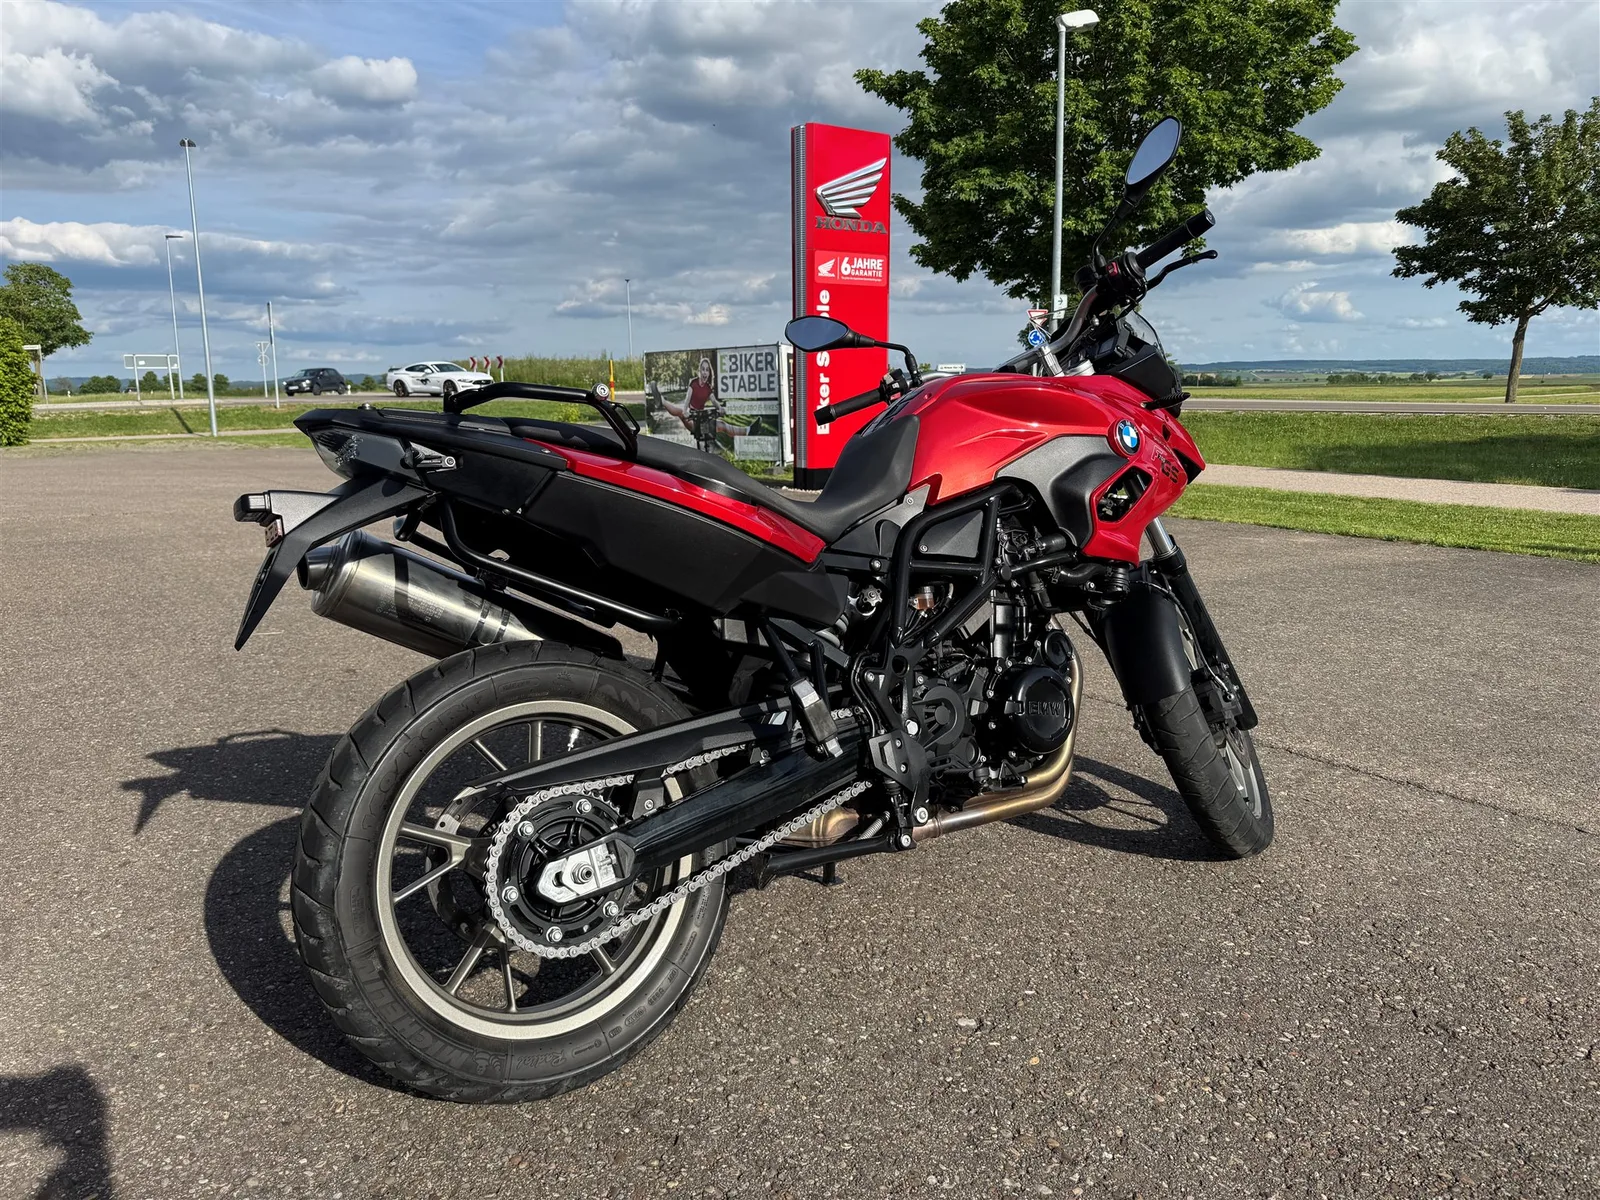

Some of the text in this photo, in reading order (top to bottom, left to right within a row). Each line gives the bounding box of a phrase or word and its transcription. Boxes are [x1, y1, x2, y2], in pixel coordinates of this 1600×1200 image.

[815, 215, 887, 234] HONDA
[841, 257, 884, 275] 6 JAHRE
[851, 269, 883, 278] GARANTIE
[720, 374, 776, 393] STABLE
[816, 373, 830, 434] Bker
[1028, 701, 1061, 717] BMW
[351, 955, 470, 1069] MICHELIN
[516, 1049, 567, 1071] Radial
